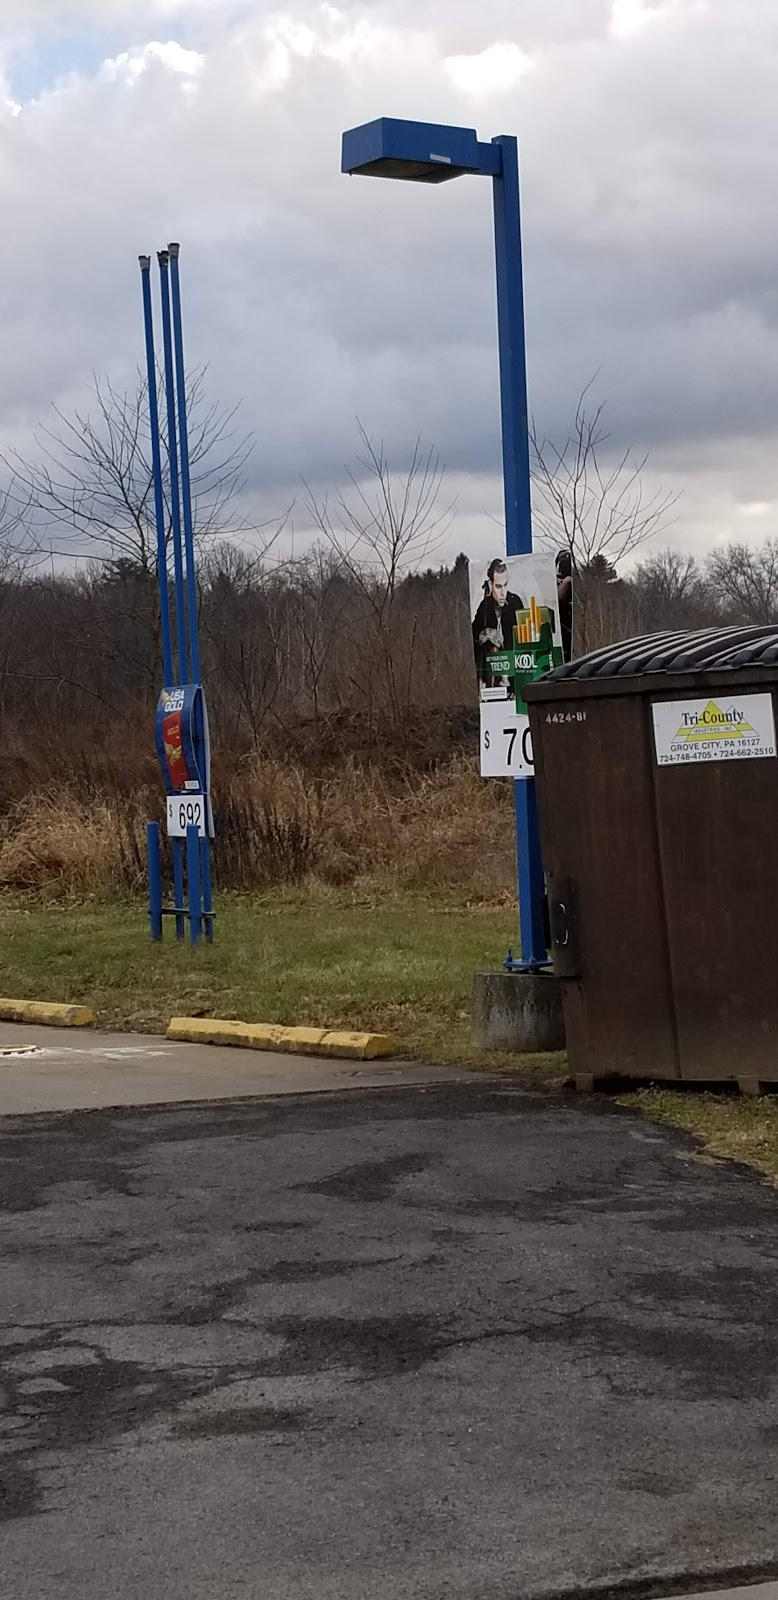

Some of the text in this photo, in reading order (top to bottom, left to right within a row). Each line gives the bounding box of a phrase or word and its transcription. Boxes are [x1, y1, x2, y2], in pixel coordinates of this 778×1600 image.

[490, 661, 510, 671] TREND
[515, 654, 538, 669] KOOL
[170, 689, 184, 701] USA
[164, 700, 184, 712] GOLD
[682, 709, 744, 725] Tri-County
[671, 743, 699, 752] GROVE
[702, 741, 722, 750] CITY,
[738, 739, 760, 747] 16127
[659, 747, 774, 762] 724-748-4705 724-662-2510
[179, 803, 201, 829] 692
